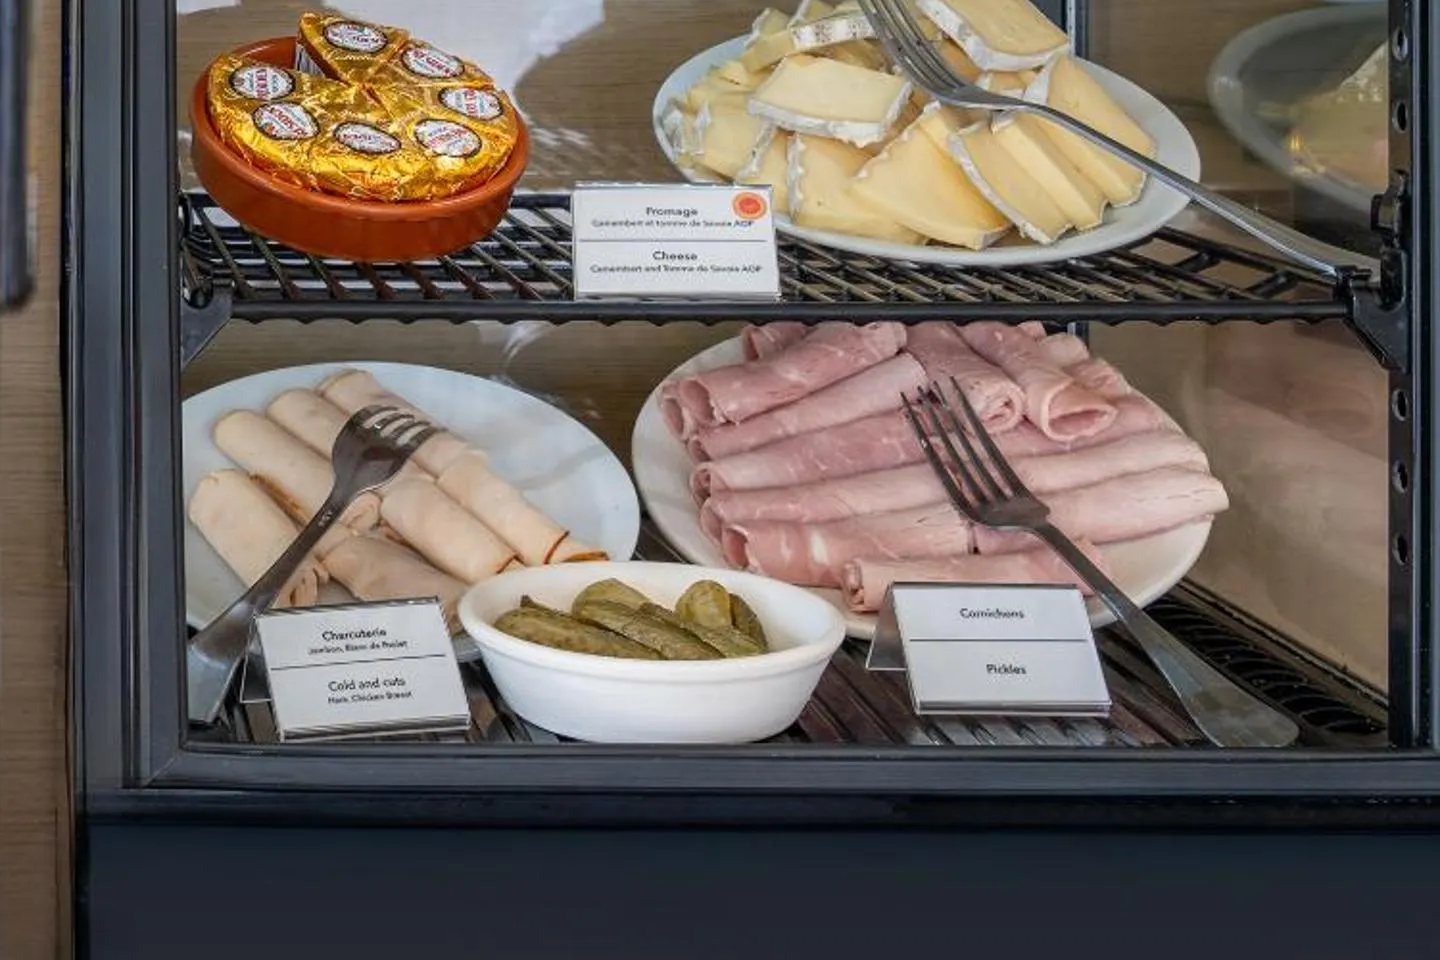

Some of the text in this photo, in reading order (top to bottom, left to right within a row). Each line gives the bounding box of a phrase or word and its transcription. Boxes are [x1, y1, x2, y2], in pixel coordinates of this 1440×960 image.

[646, 207, 698, 217] Fromage
[733, 220, 755, 228] AOP
[653, 251, 698, 260] Cheese
[590, 264, 642, 273] Camembert
[742, 265, 762, 273] AOP
[960, 608, 1025, 619] Cornichons
[322, 628, 387, 641] Charcuterie
[986, 664, 1026, 675] Pickles
[328, 677, 406, 692] Cold and cuts
